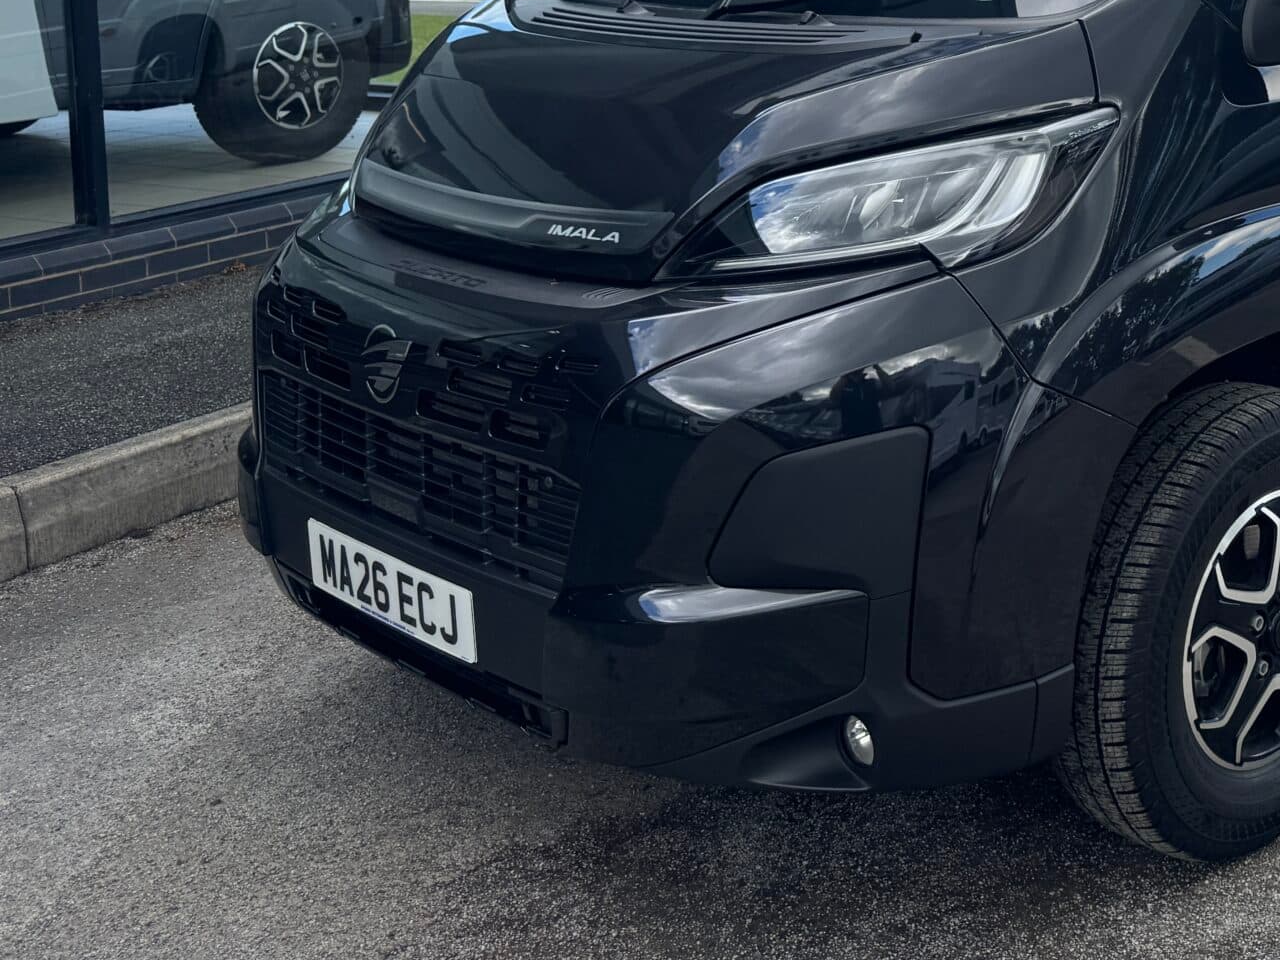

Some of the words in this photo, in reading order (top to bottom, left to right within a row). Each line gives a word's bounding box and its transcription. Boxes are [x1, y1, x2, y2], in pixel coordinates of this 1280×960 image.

[547, 224, 620, 244] IMALA
[319, 534, 390, 614] MA26
[396, 570, 459, 646] ECJ
